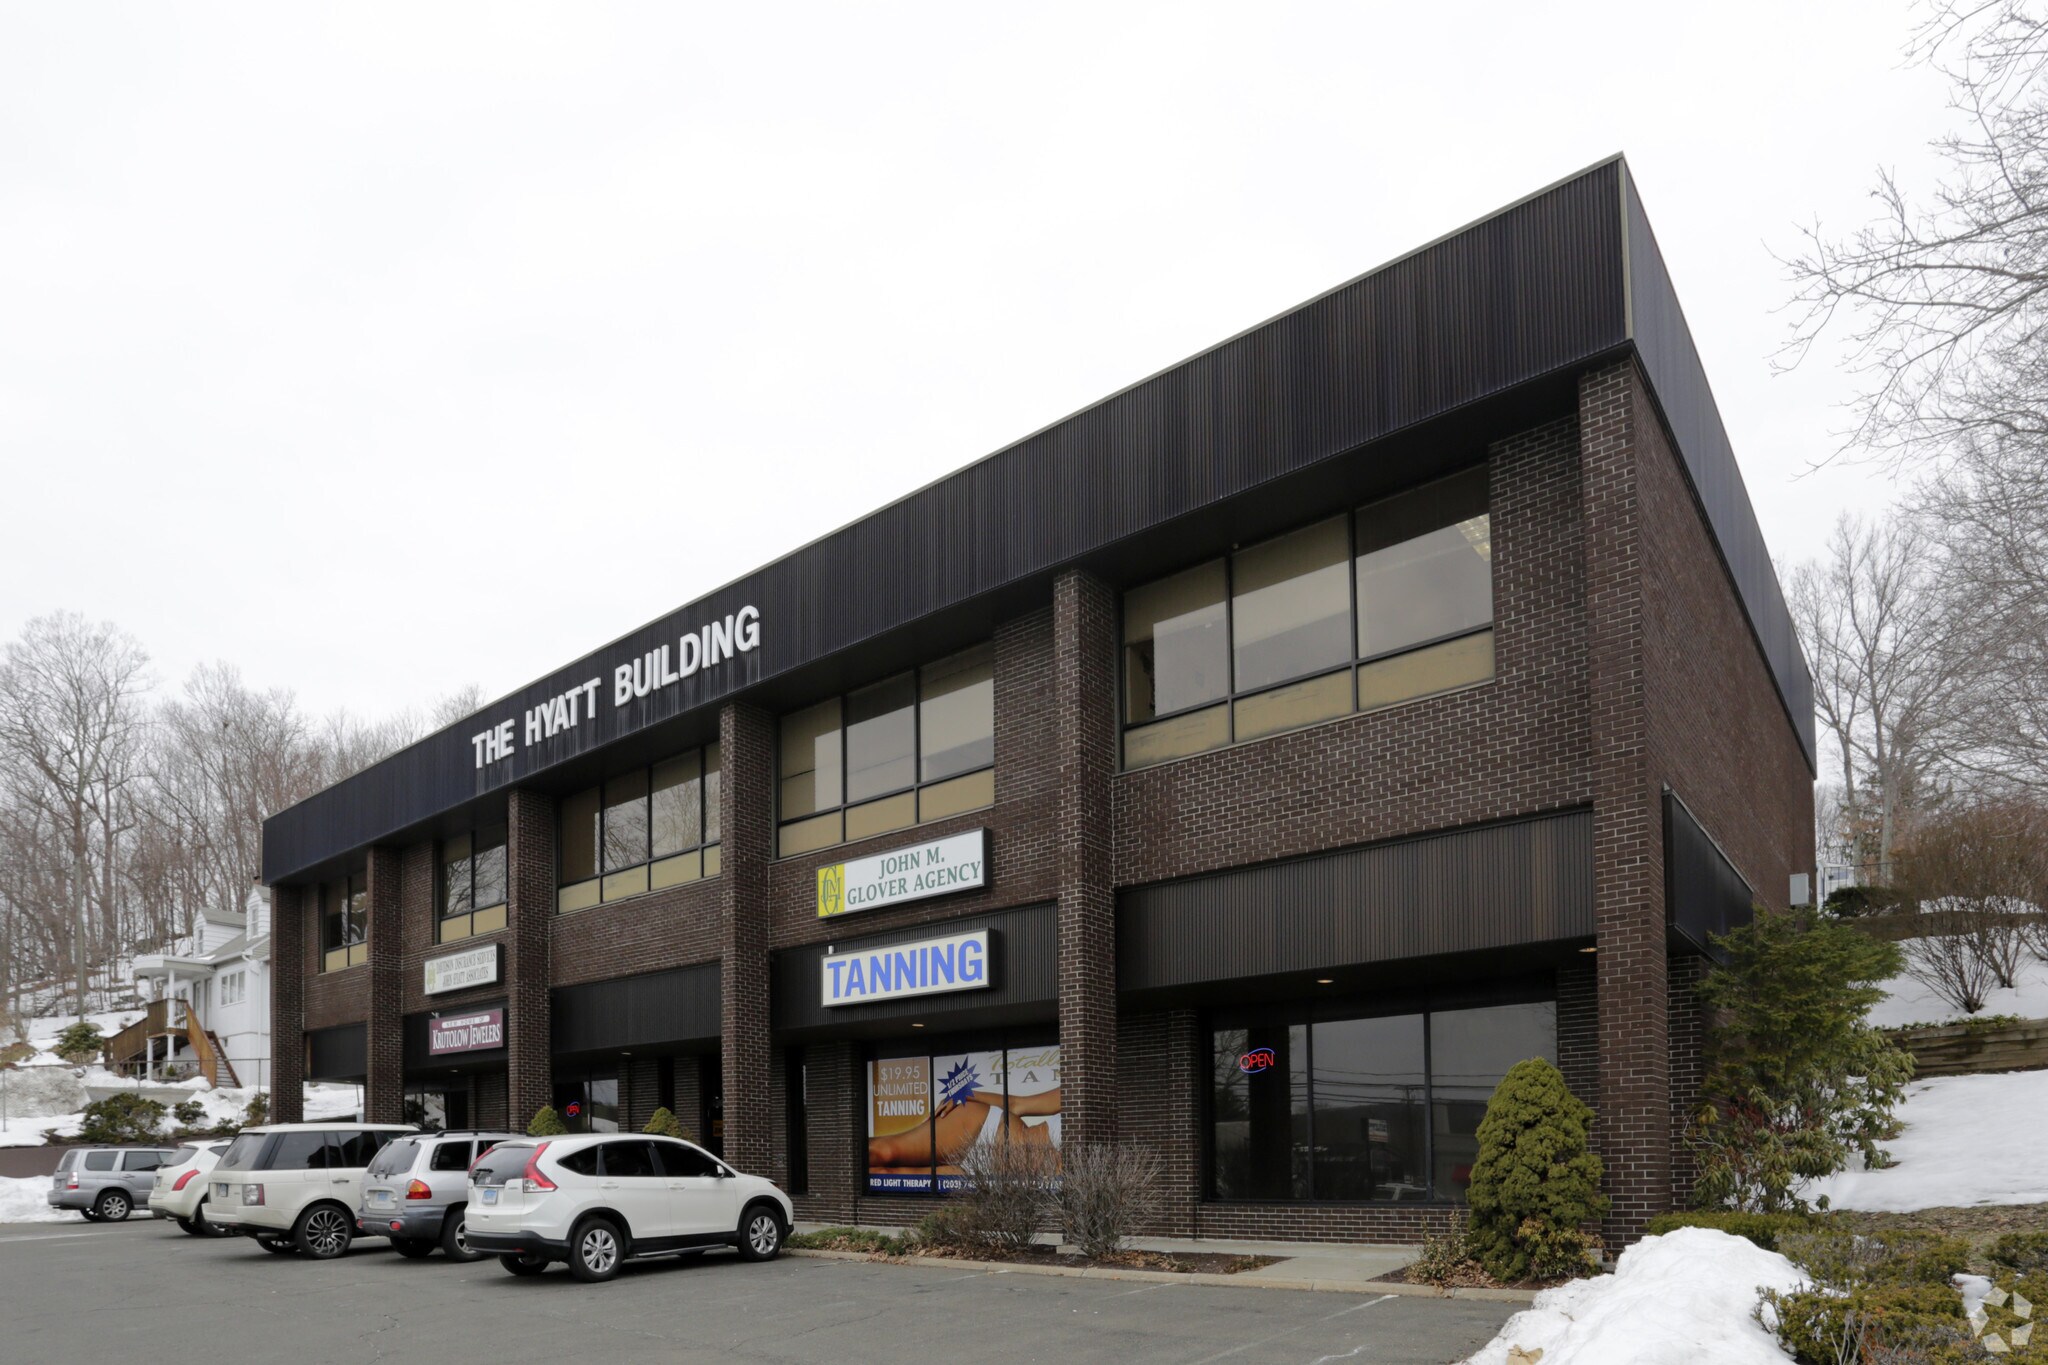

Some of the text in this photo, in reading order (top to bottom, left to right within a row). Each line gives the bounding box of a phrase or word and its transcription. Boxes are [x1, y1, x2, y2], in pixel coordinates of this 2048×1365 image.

[472, 605, 761, 769] THE HYATT BUILDING
[878, 847, 945, 880] JOHN M.
[847, 861, 982, 905] GLOVER AGENCY
[827, 939, 983, 999] TANNING
[468, 1024, 500, 1048] JEWELERS
[989, 1049, 1060, 1071] Totall
[1240, 1053, 1274, 1069] OPEN
[880, 1066, 920, 1082] $19.95
[873, 1081, 928, 1097] UNLIMITED
[877, 1099, 925, 1117] TANNING
[870, 1178, 882, 1187] RED
[883, 1179, 902, 1187] LIGHT
[902, 1179, 932, 1188] THERAPY
[942, 1179, 961, 1190] (203)
